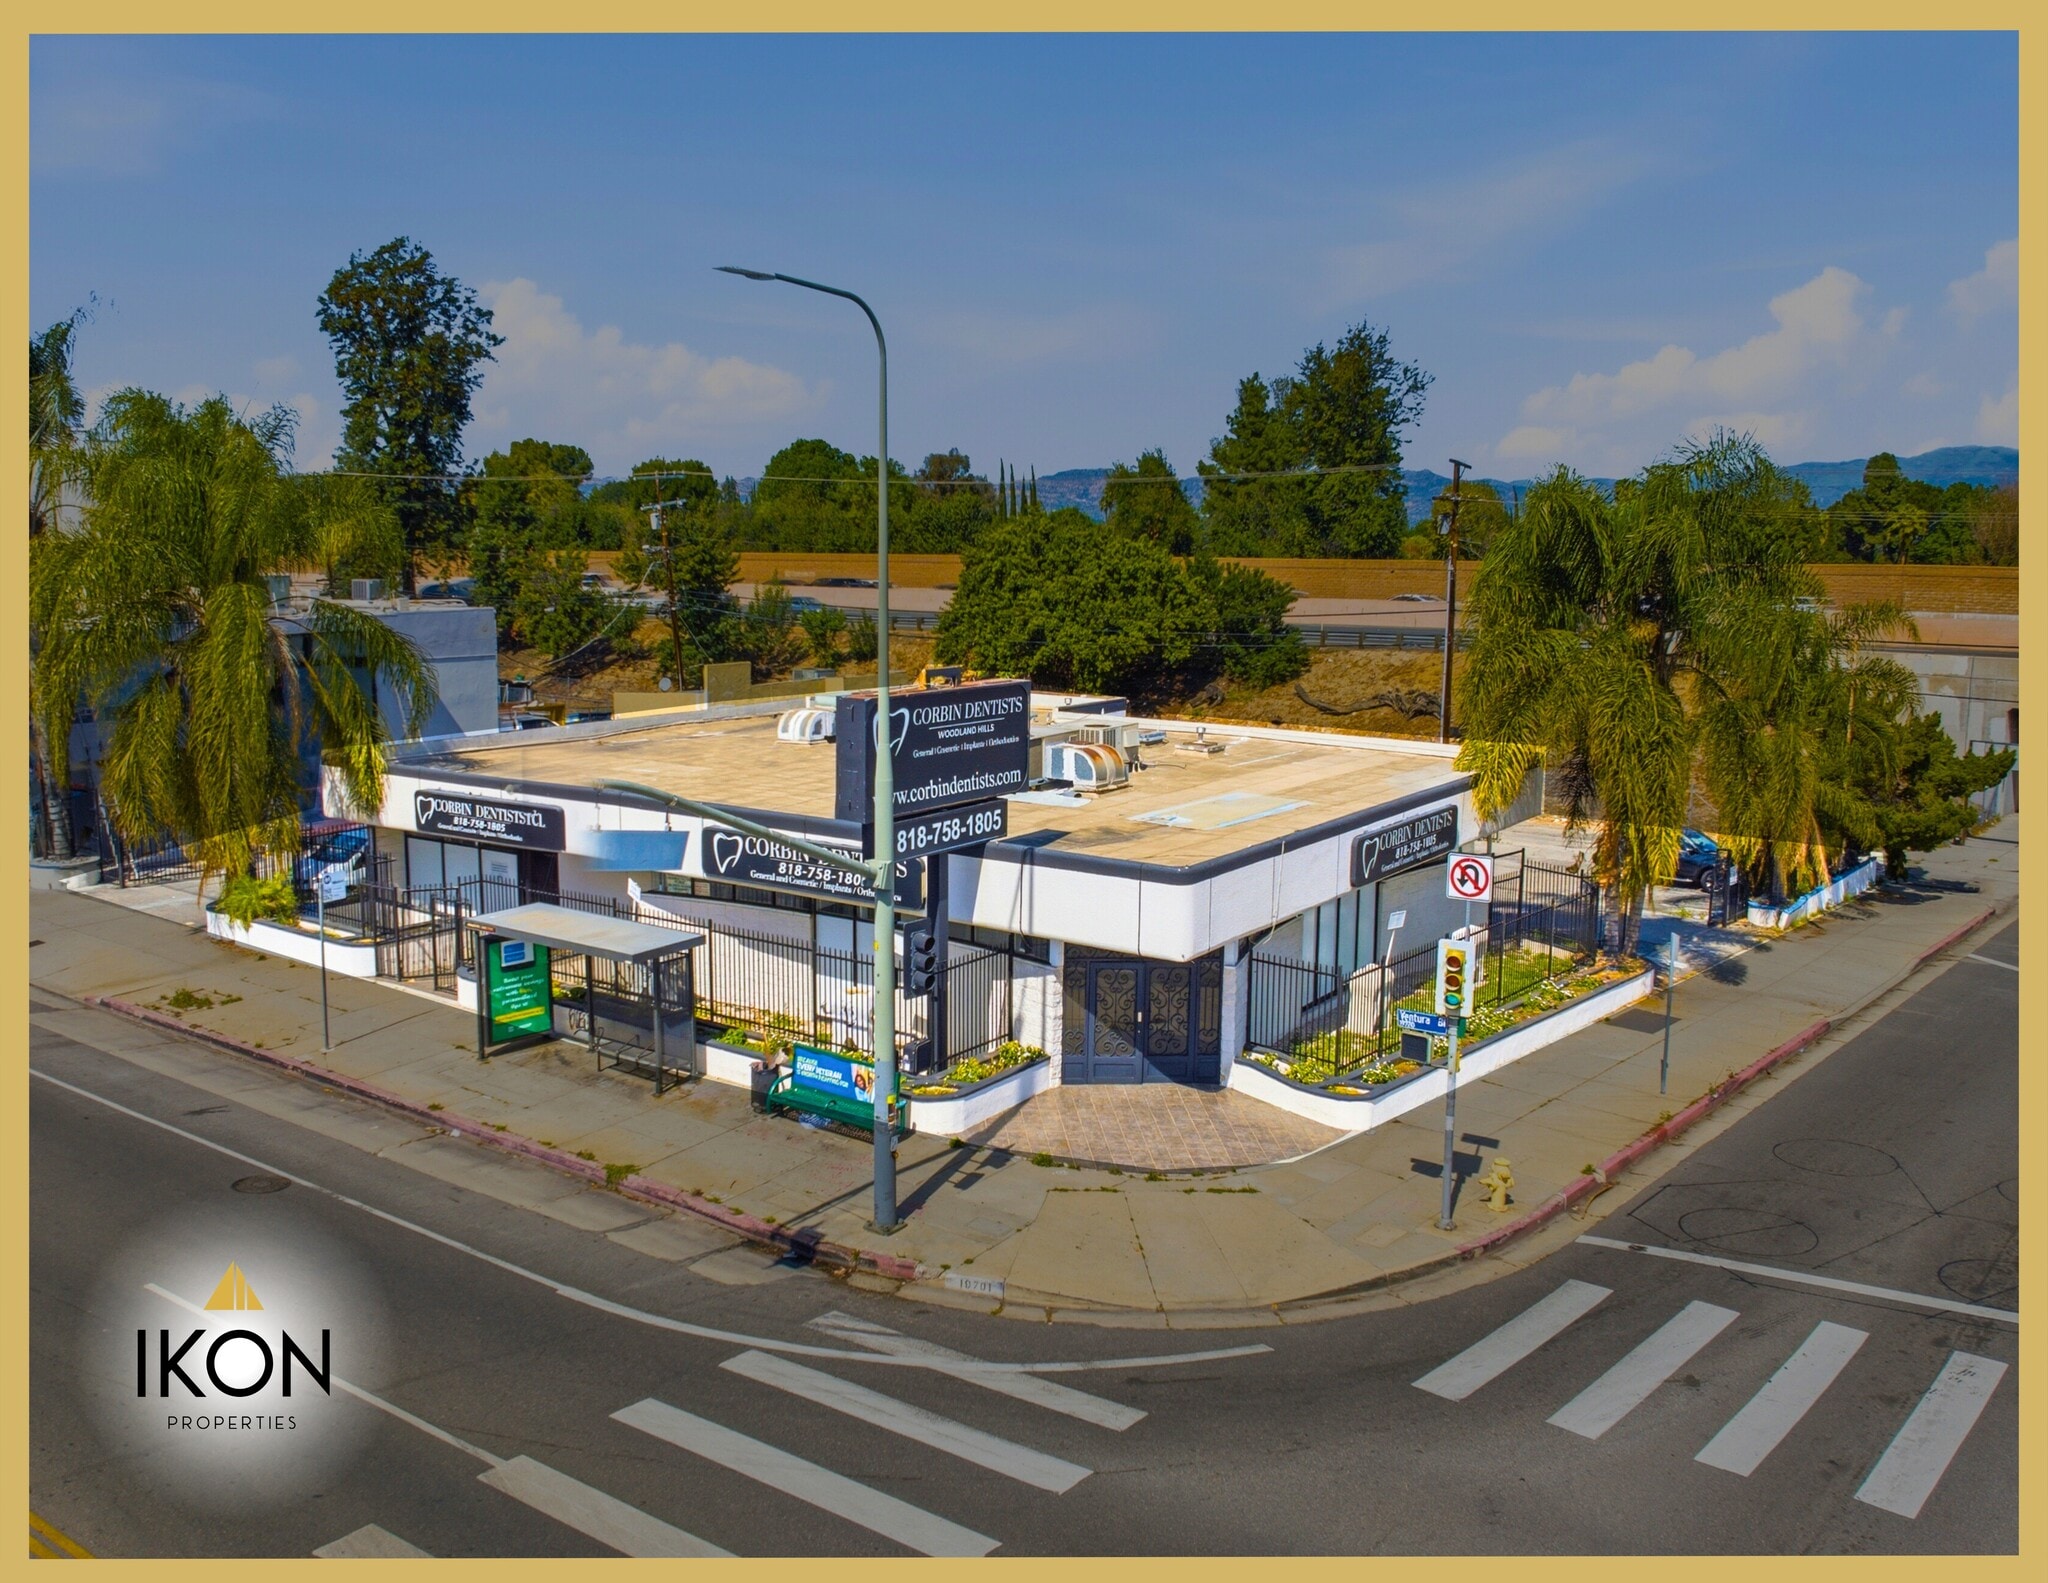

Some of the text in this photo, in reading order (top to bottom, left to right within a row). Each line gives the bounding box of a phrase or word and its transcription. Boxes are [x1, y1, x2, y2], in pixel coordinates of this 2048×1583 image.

[912, 696, 1023, 726] CORBIN DENTISTS
[937, 723, 995, 739] WOODLAND HILLS
[433, 799, 473, 816] CORBIN
[897, 809, 1002, 853] 818-758-1805
[1380, 810, 1453, 851] CORBIN DENTISTS
[750, 869, 775, 881] General
[776, 874, 788, 884] and
[789, 876, 818, 888] Cosmetic
[823, 881, 852, 894] Implants
[1400, 1010, 1430, 1025] Ventura
[797, 1061, 843, 1080] EVERY VETERAN
